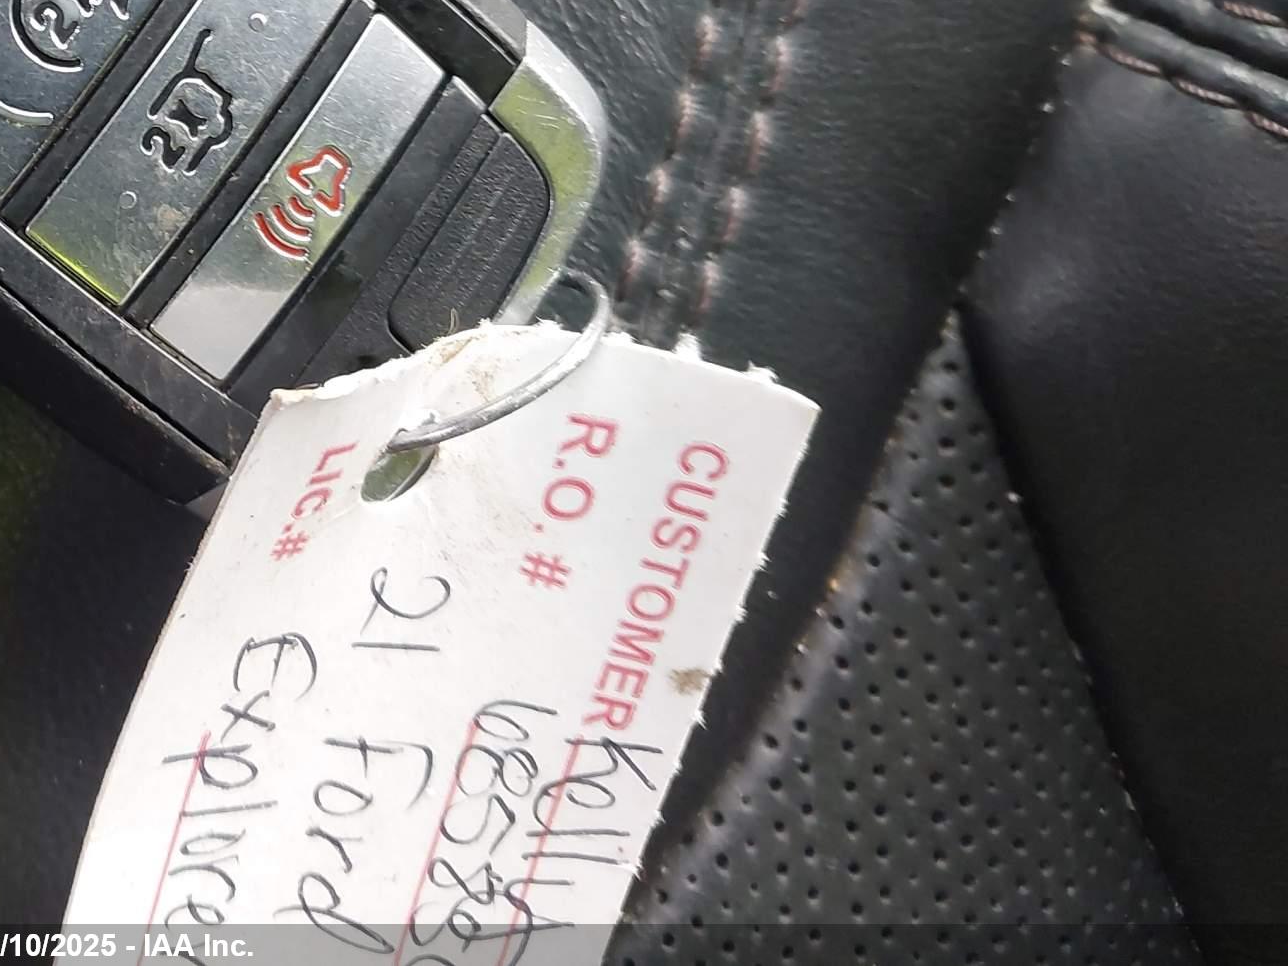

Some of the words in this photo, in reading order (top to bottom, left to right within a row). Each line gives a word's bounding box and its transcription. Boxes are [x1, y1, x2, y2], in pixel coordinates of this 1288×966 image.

[350, 565, 452, 653] 21
[581, 440, 730, 732] CUSTOMER
[272, 735, 435, 955] Ford
